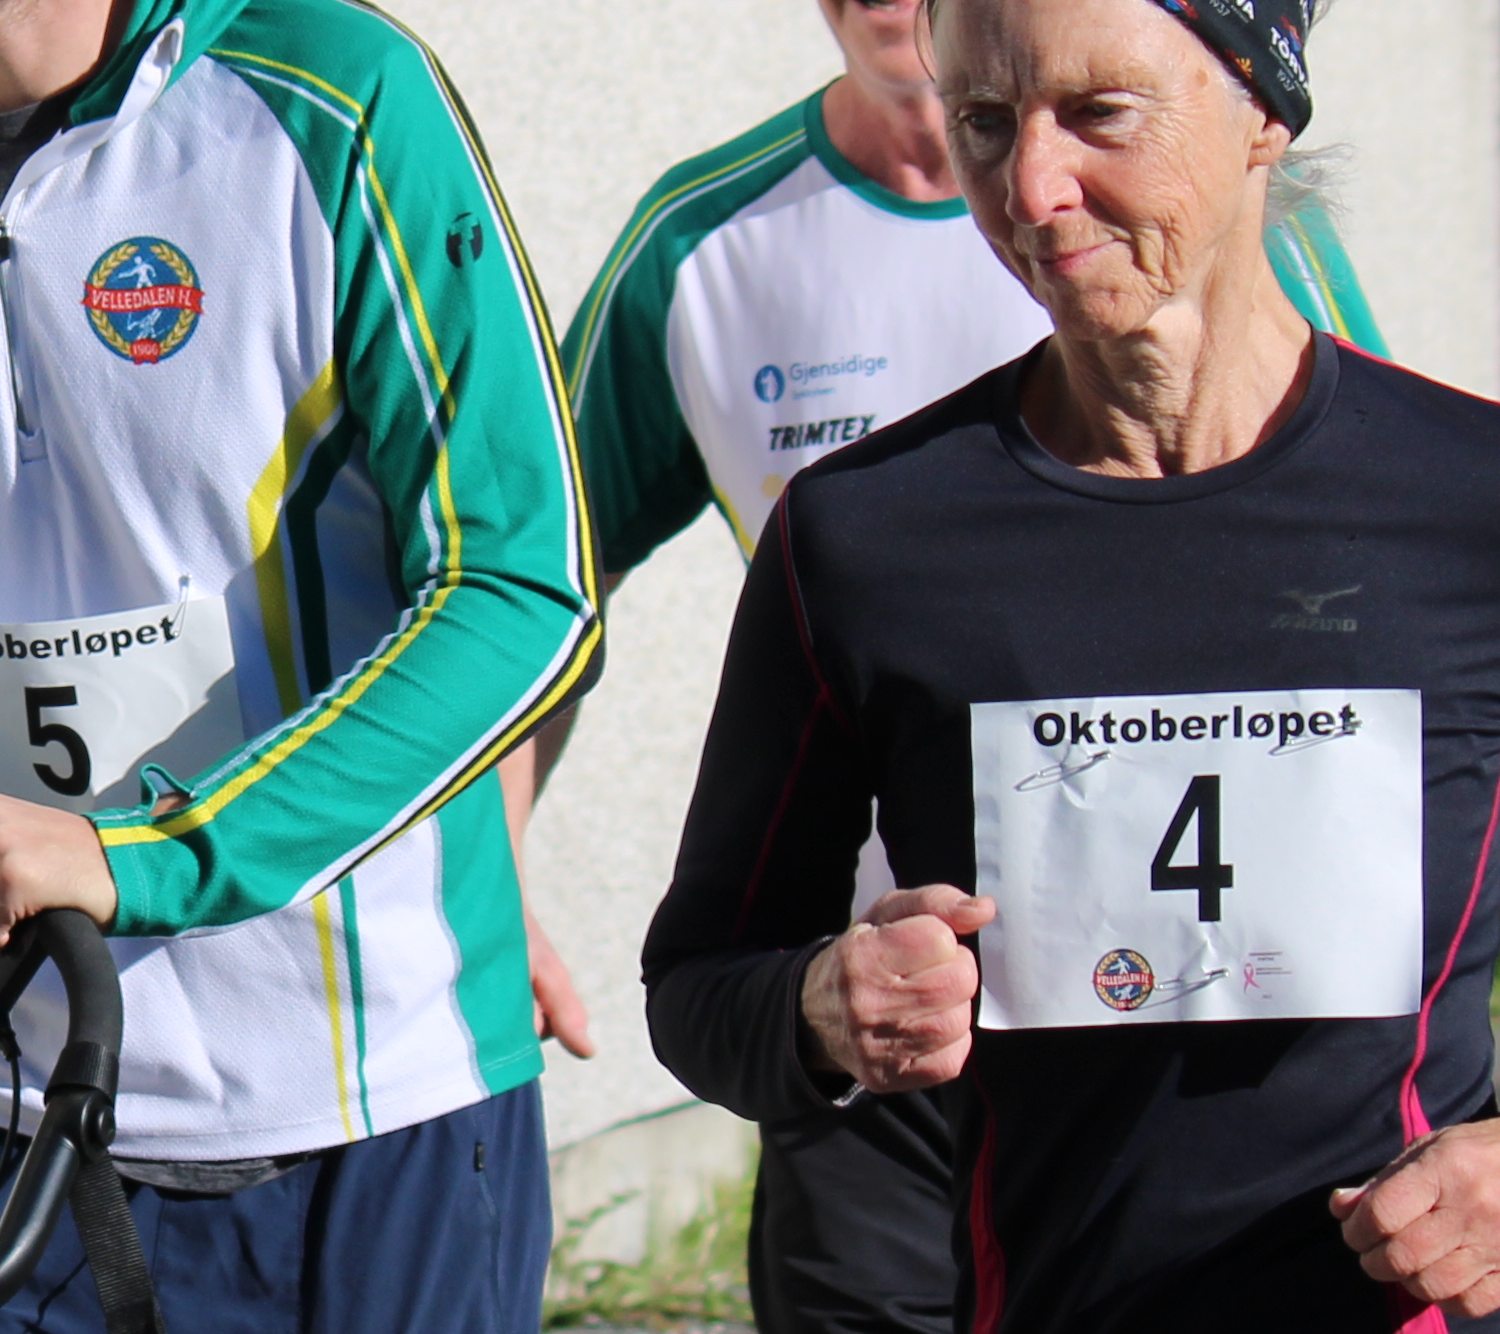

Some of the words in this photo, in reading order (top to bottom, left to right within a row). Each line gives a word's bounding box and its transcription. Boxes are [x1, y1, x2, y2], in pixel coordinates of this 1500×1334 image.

[92, 287, 176, 310] VELLEDALEN
[789, 353, 888, 386] Gjensidige
[769, 413, 876, 452] TRIMTEX
[22, 685, 93, 799] 5
[1033, 701, 1360, 747] Oktoberløpet
[1150, 773, 1235, 922] 4
